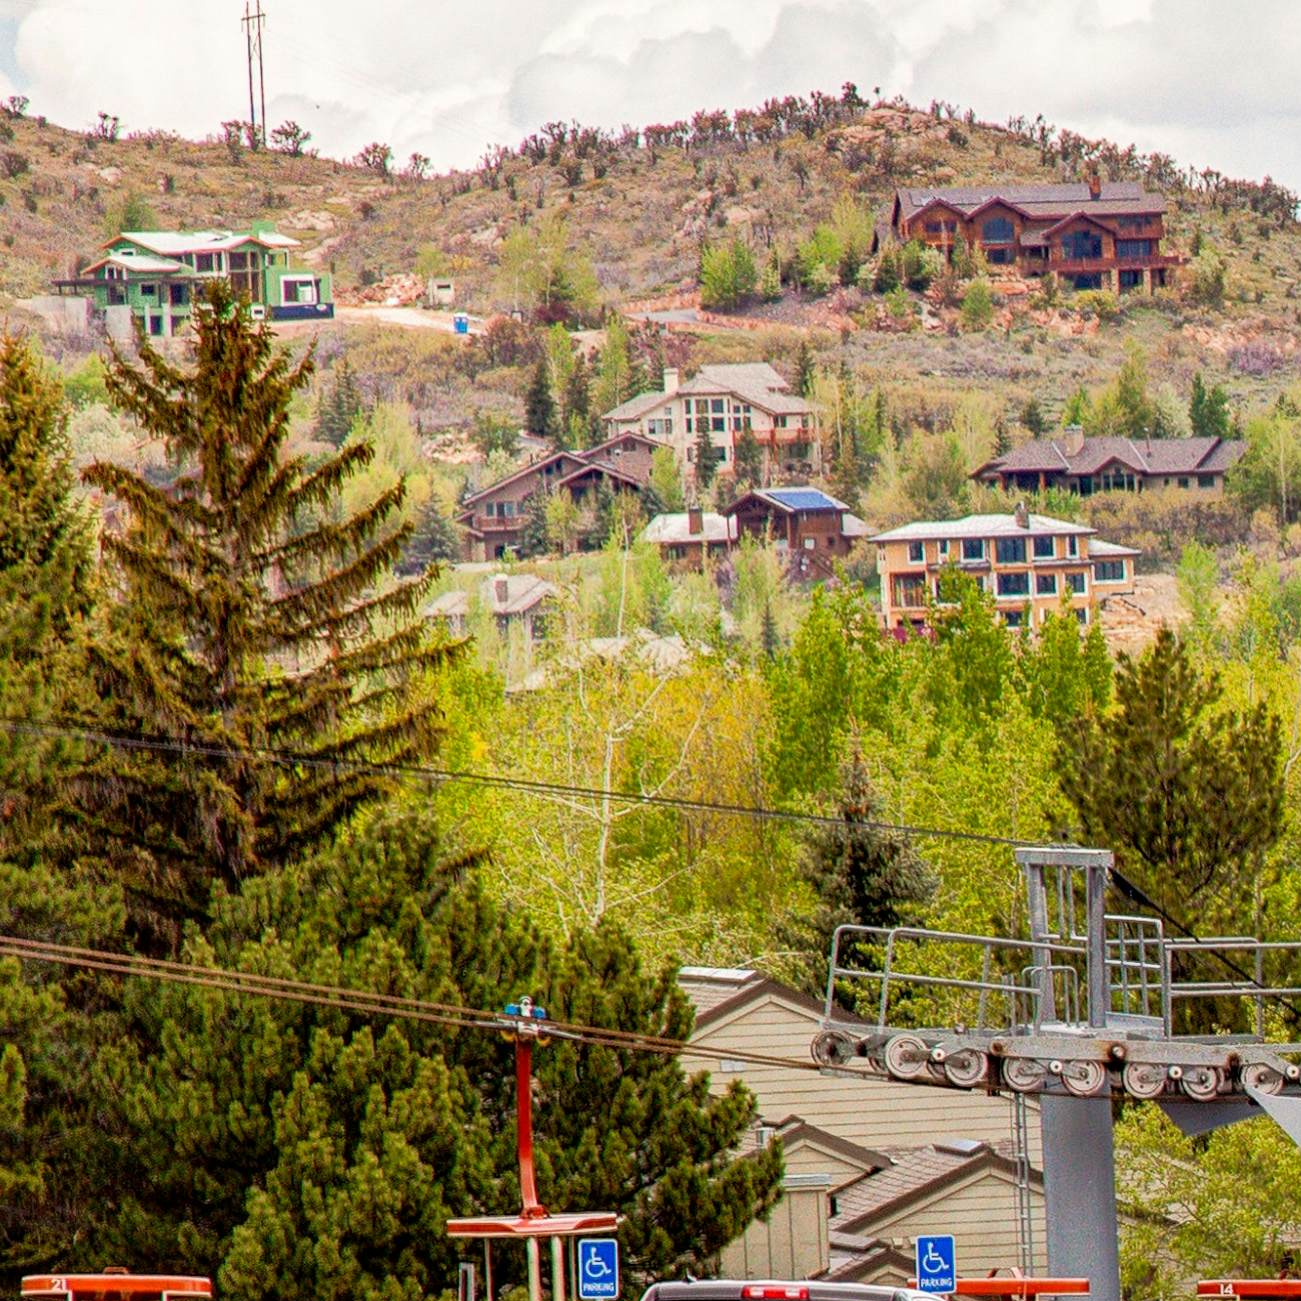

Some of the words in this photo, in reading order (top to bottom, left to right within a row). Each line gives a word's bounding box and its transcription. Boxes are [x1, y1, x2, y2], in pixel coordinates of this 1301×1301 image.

[51, 1278, 67, 1291] 21
[583, 1281, 615, 1292] PARKING
[920, 1277, 953, 1288] PARKING
[1219, 1283, 1234, 1296] 14
